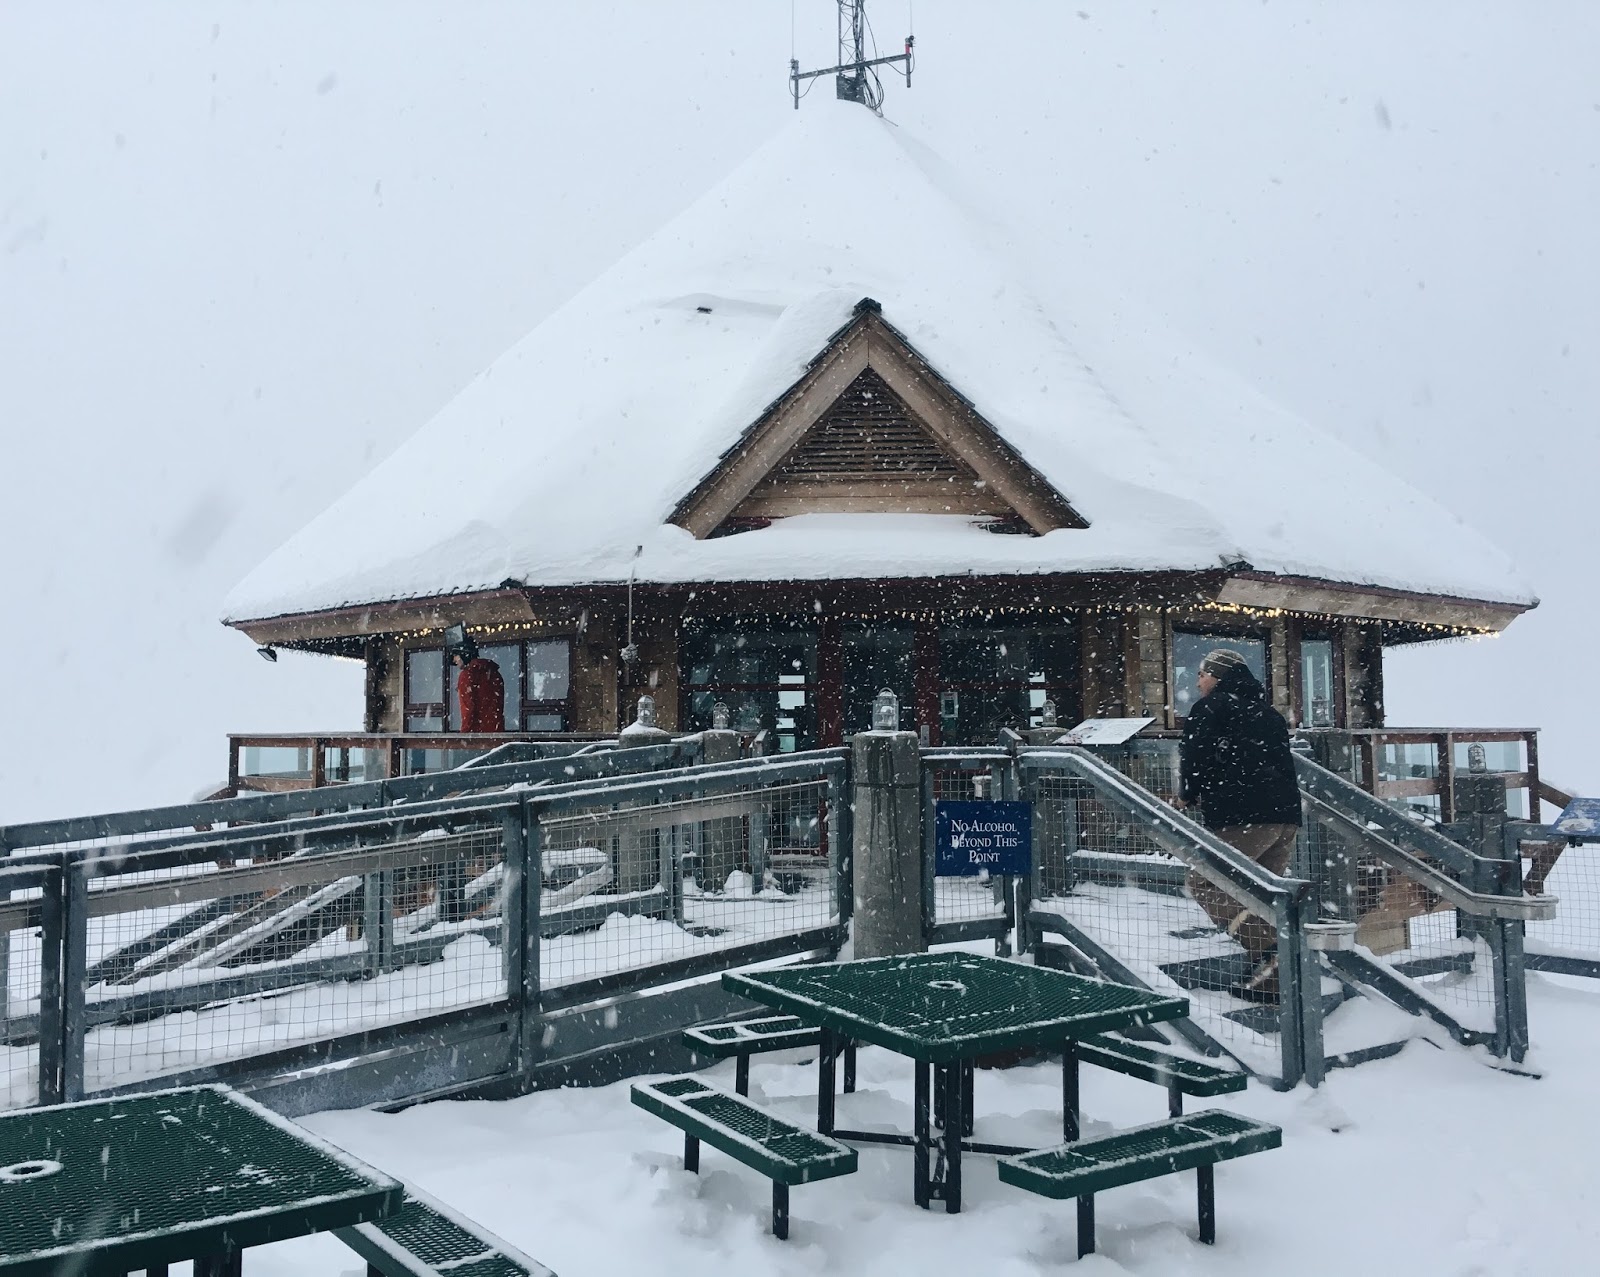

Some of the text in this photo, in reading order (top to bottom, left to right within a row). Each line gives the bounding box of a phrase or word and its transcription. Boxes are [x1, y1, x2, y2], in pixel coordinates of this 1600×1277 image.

[951, 820, 1017, 832] NO ALCOHOL
[993, 834, 1018, 847] THIS
[968, 850, 1000, 862] POINT
